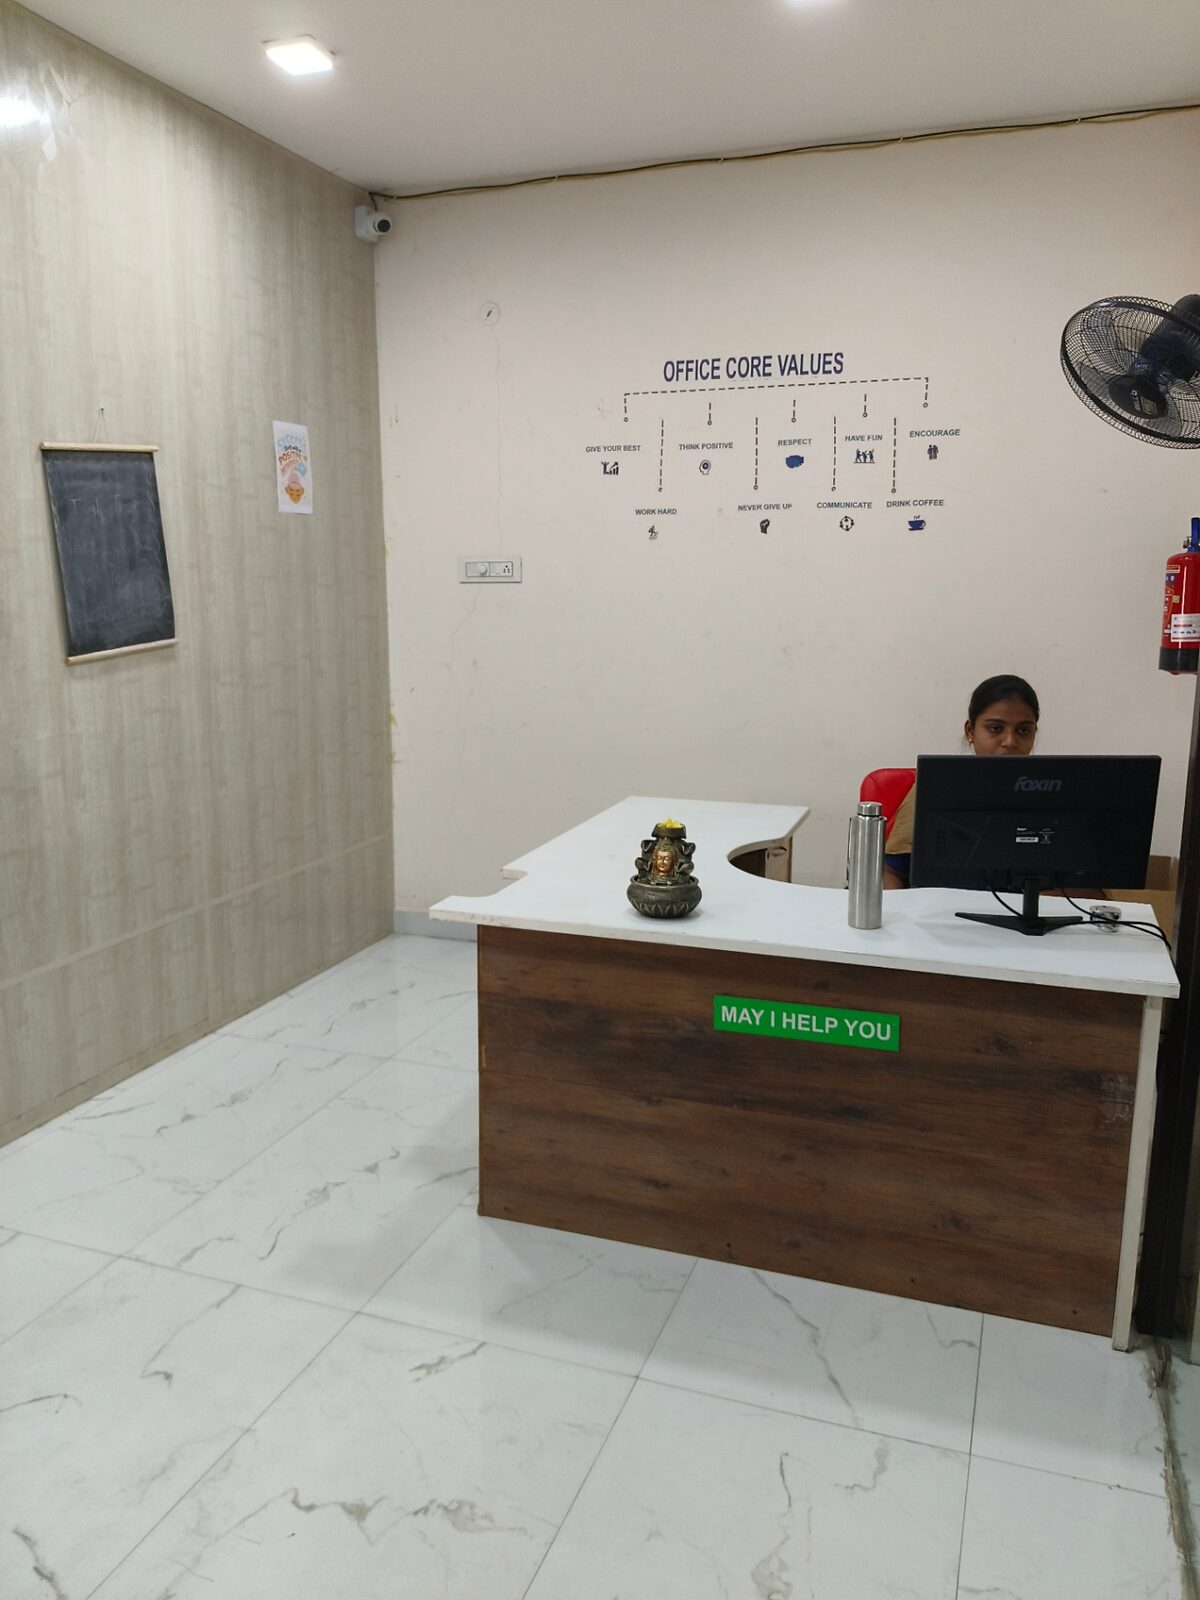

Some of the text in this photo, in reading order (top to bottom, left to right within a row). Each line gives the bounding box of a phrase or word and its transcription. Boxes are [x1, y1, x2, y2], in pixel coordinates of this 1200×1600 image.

[663, 352, 844, 382] OFFICE CORE VALUES
[909, 428, 960, 438] ENCOURAGE
[679, 442, 734, 451] THINK POSITIVE
[777, 438, 812, 447] RESPECT
[816, 501, 873, 509] COMMUNICATE
[886, 499, 944, 508] DRINK COFFEE
[721, 1005, 892, 1041] MAY I HELP YOU
